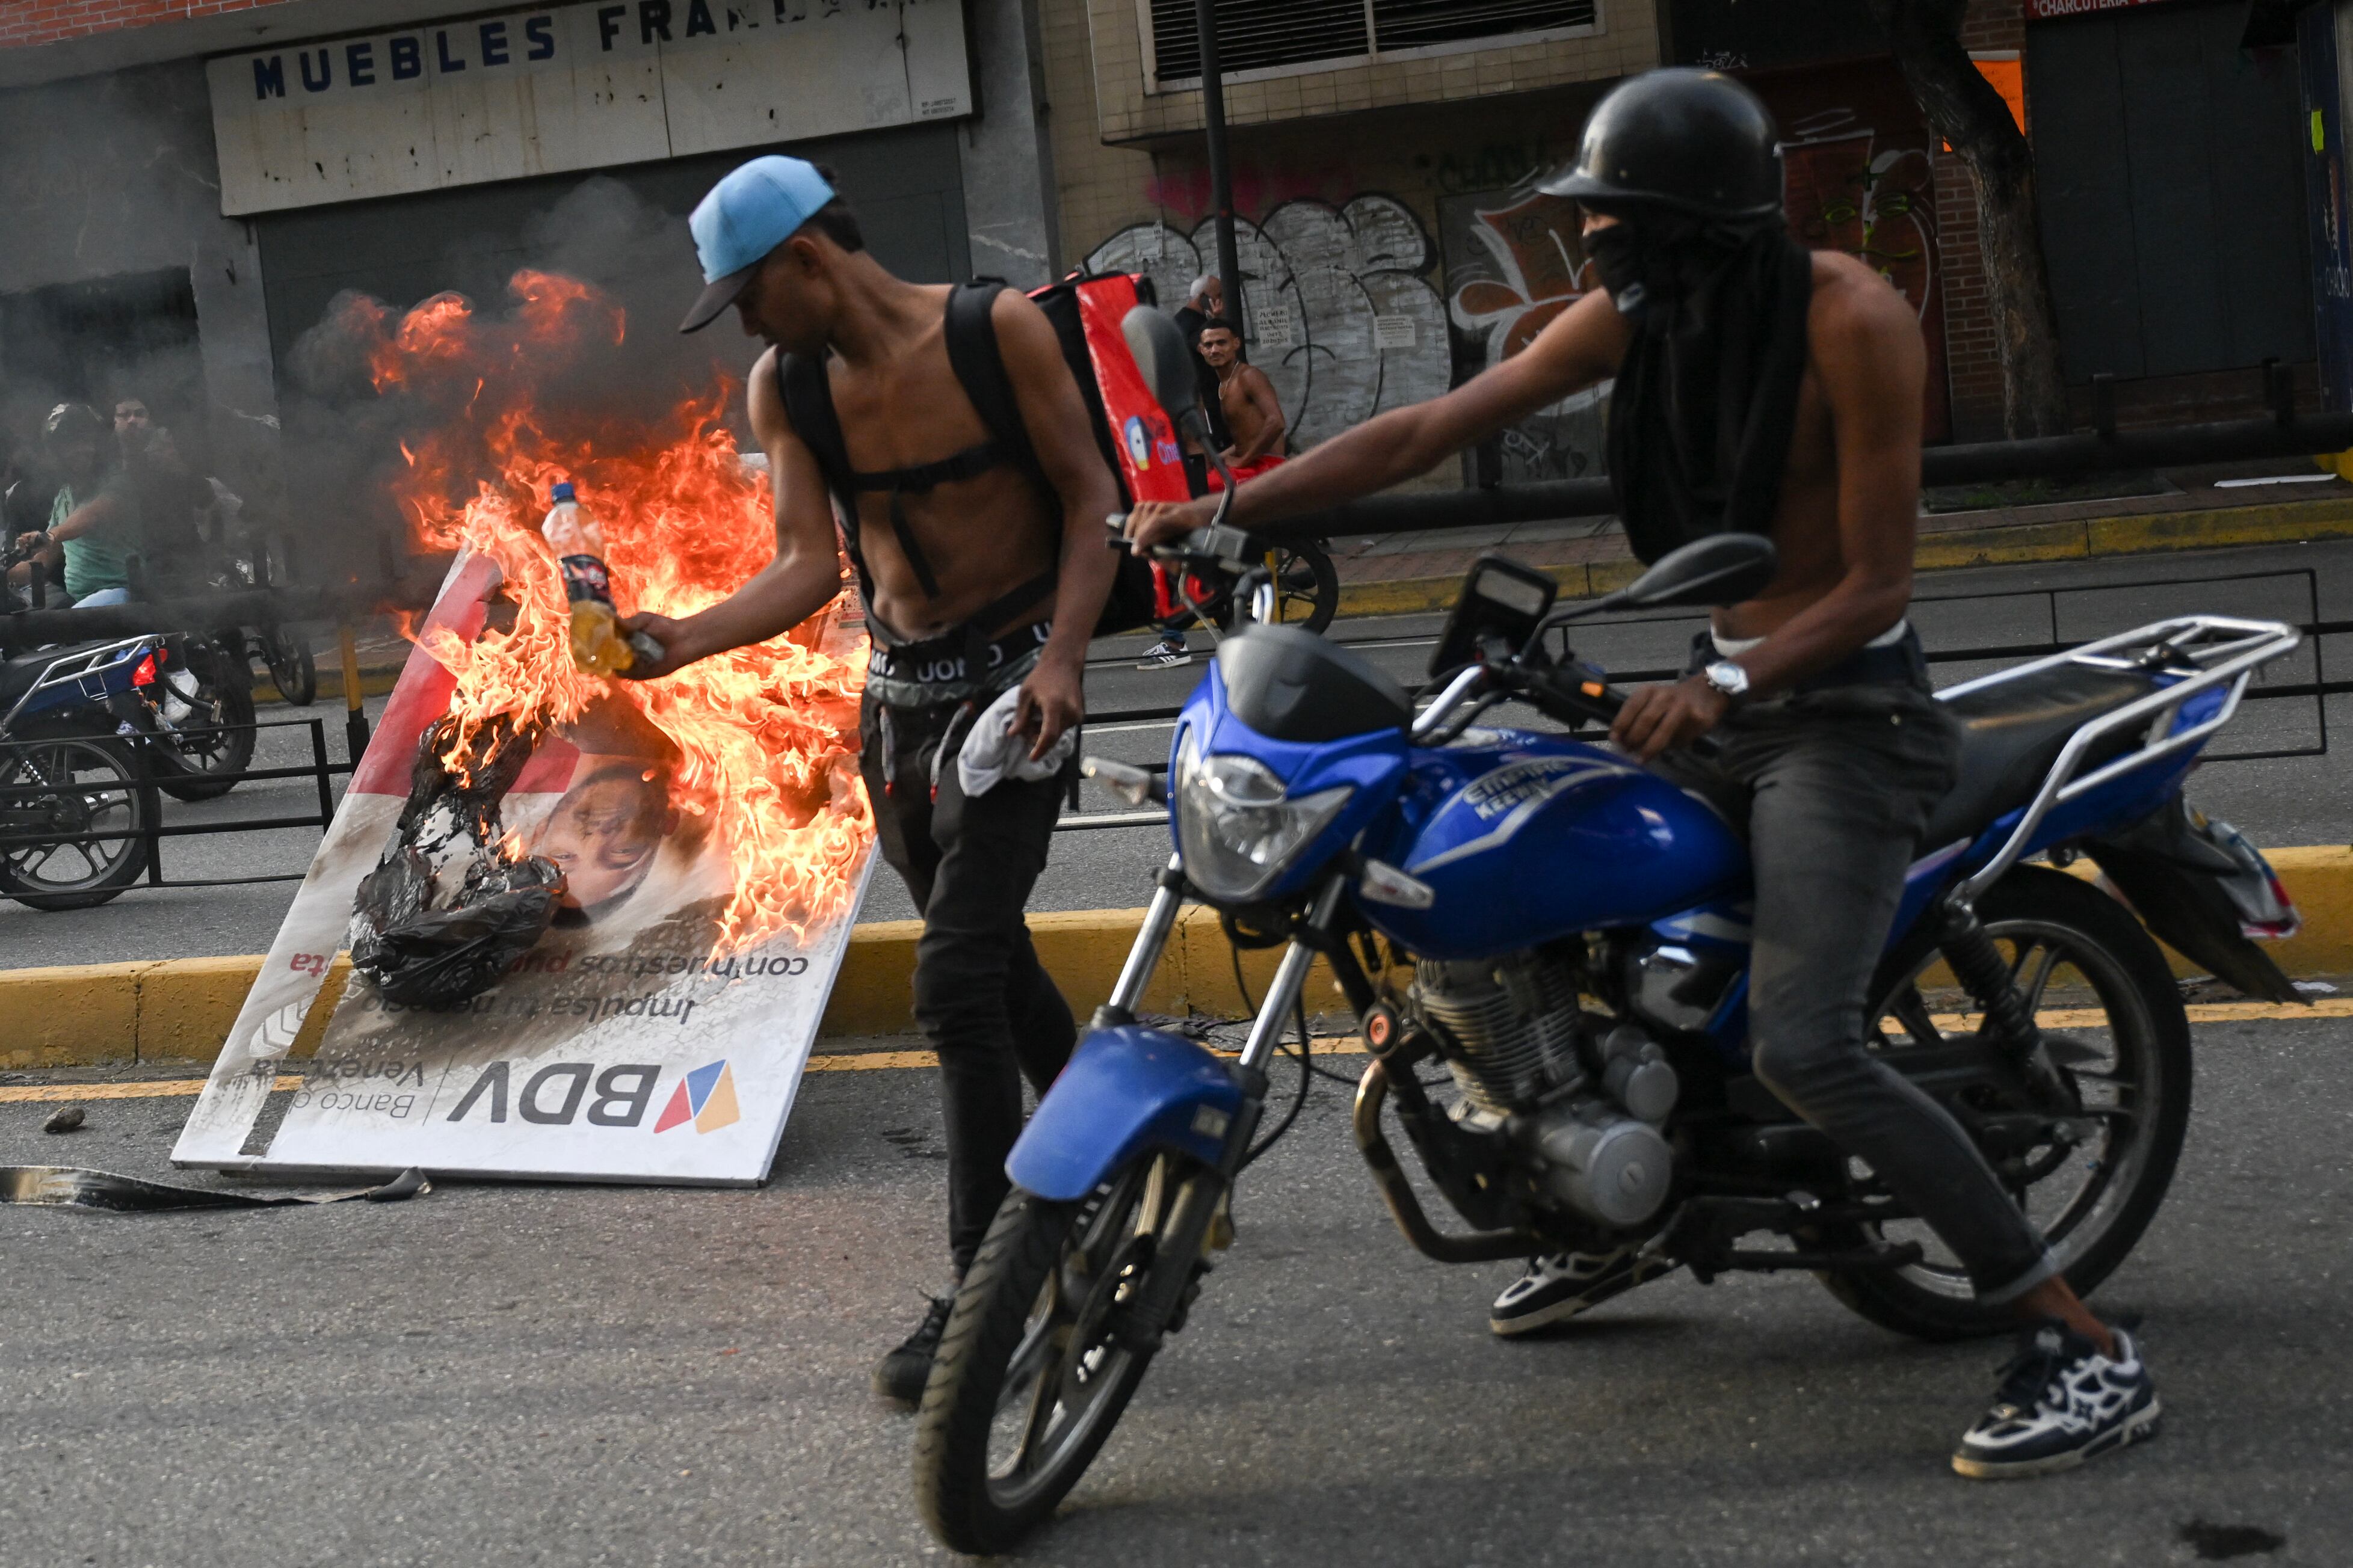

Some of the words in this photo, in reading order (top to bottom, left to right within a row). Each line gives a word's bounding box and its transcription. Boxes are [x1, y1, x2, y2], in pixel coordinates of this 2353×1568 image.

[253, 15, 555, 100] MUEBLES
[290, 953, 330, 977] ta
[580, 955, 736, 978] nuestros
[744, 956, 809, 976] con
[504, 997, 538, 1018] tu
[550, 992, 696, 1025] Impulsa
[252, 1059, 425, 1087] Venezla
[288, 1092, 312, 1115] d
[320, 1092, 416, 1119] Banco
[446, 1060, 662, 1127] BDV
